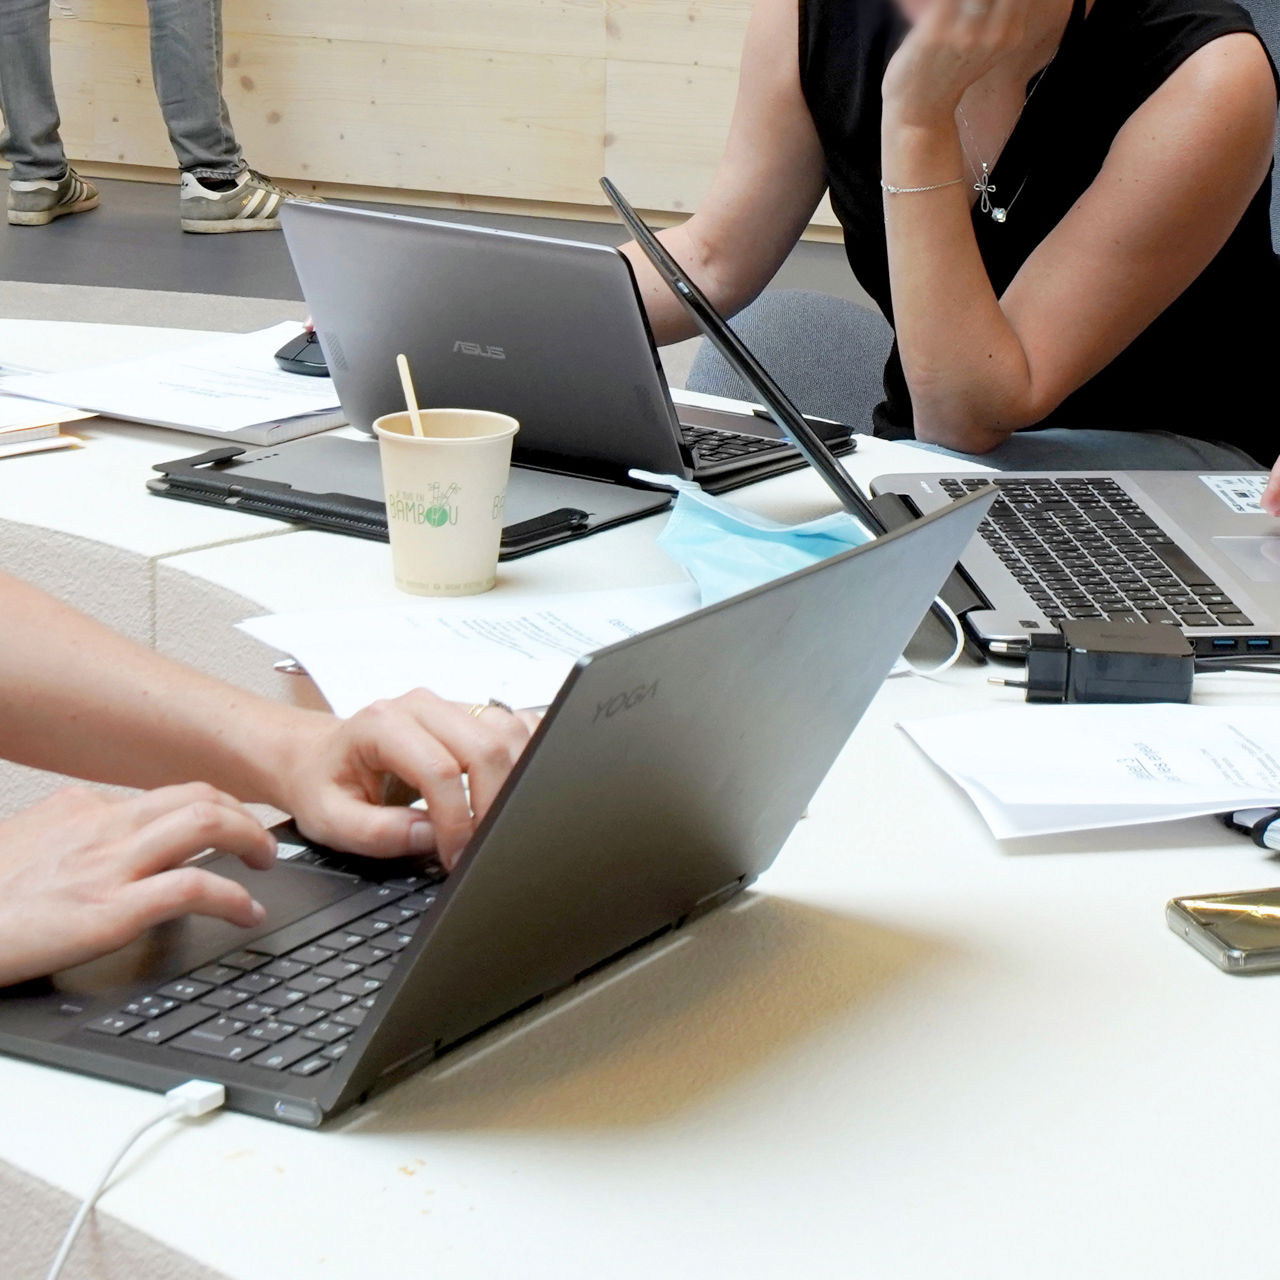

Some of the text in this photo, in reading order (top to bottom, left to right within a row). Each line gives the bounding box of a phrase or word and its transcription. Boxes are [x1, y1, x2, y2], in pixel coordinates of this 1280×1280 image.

[453, 340, 506, 360] ASUS
[390, 494, 458, 527] BAMBOU
[592, 679, 661, 724] YOGA
